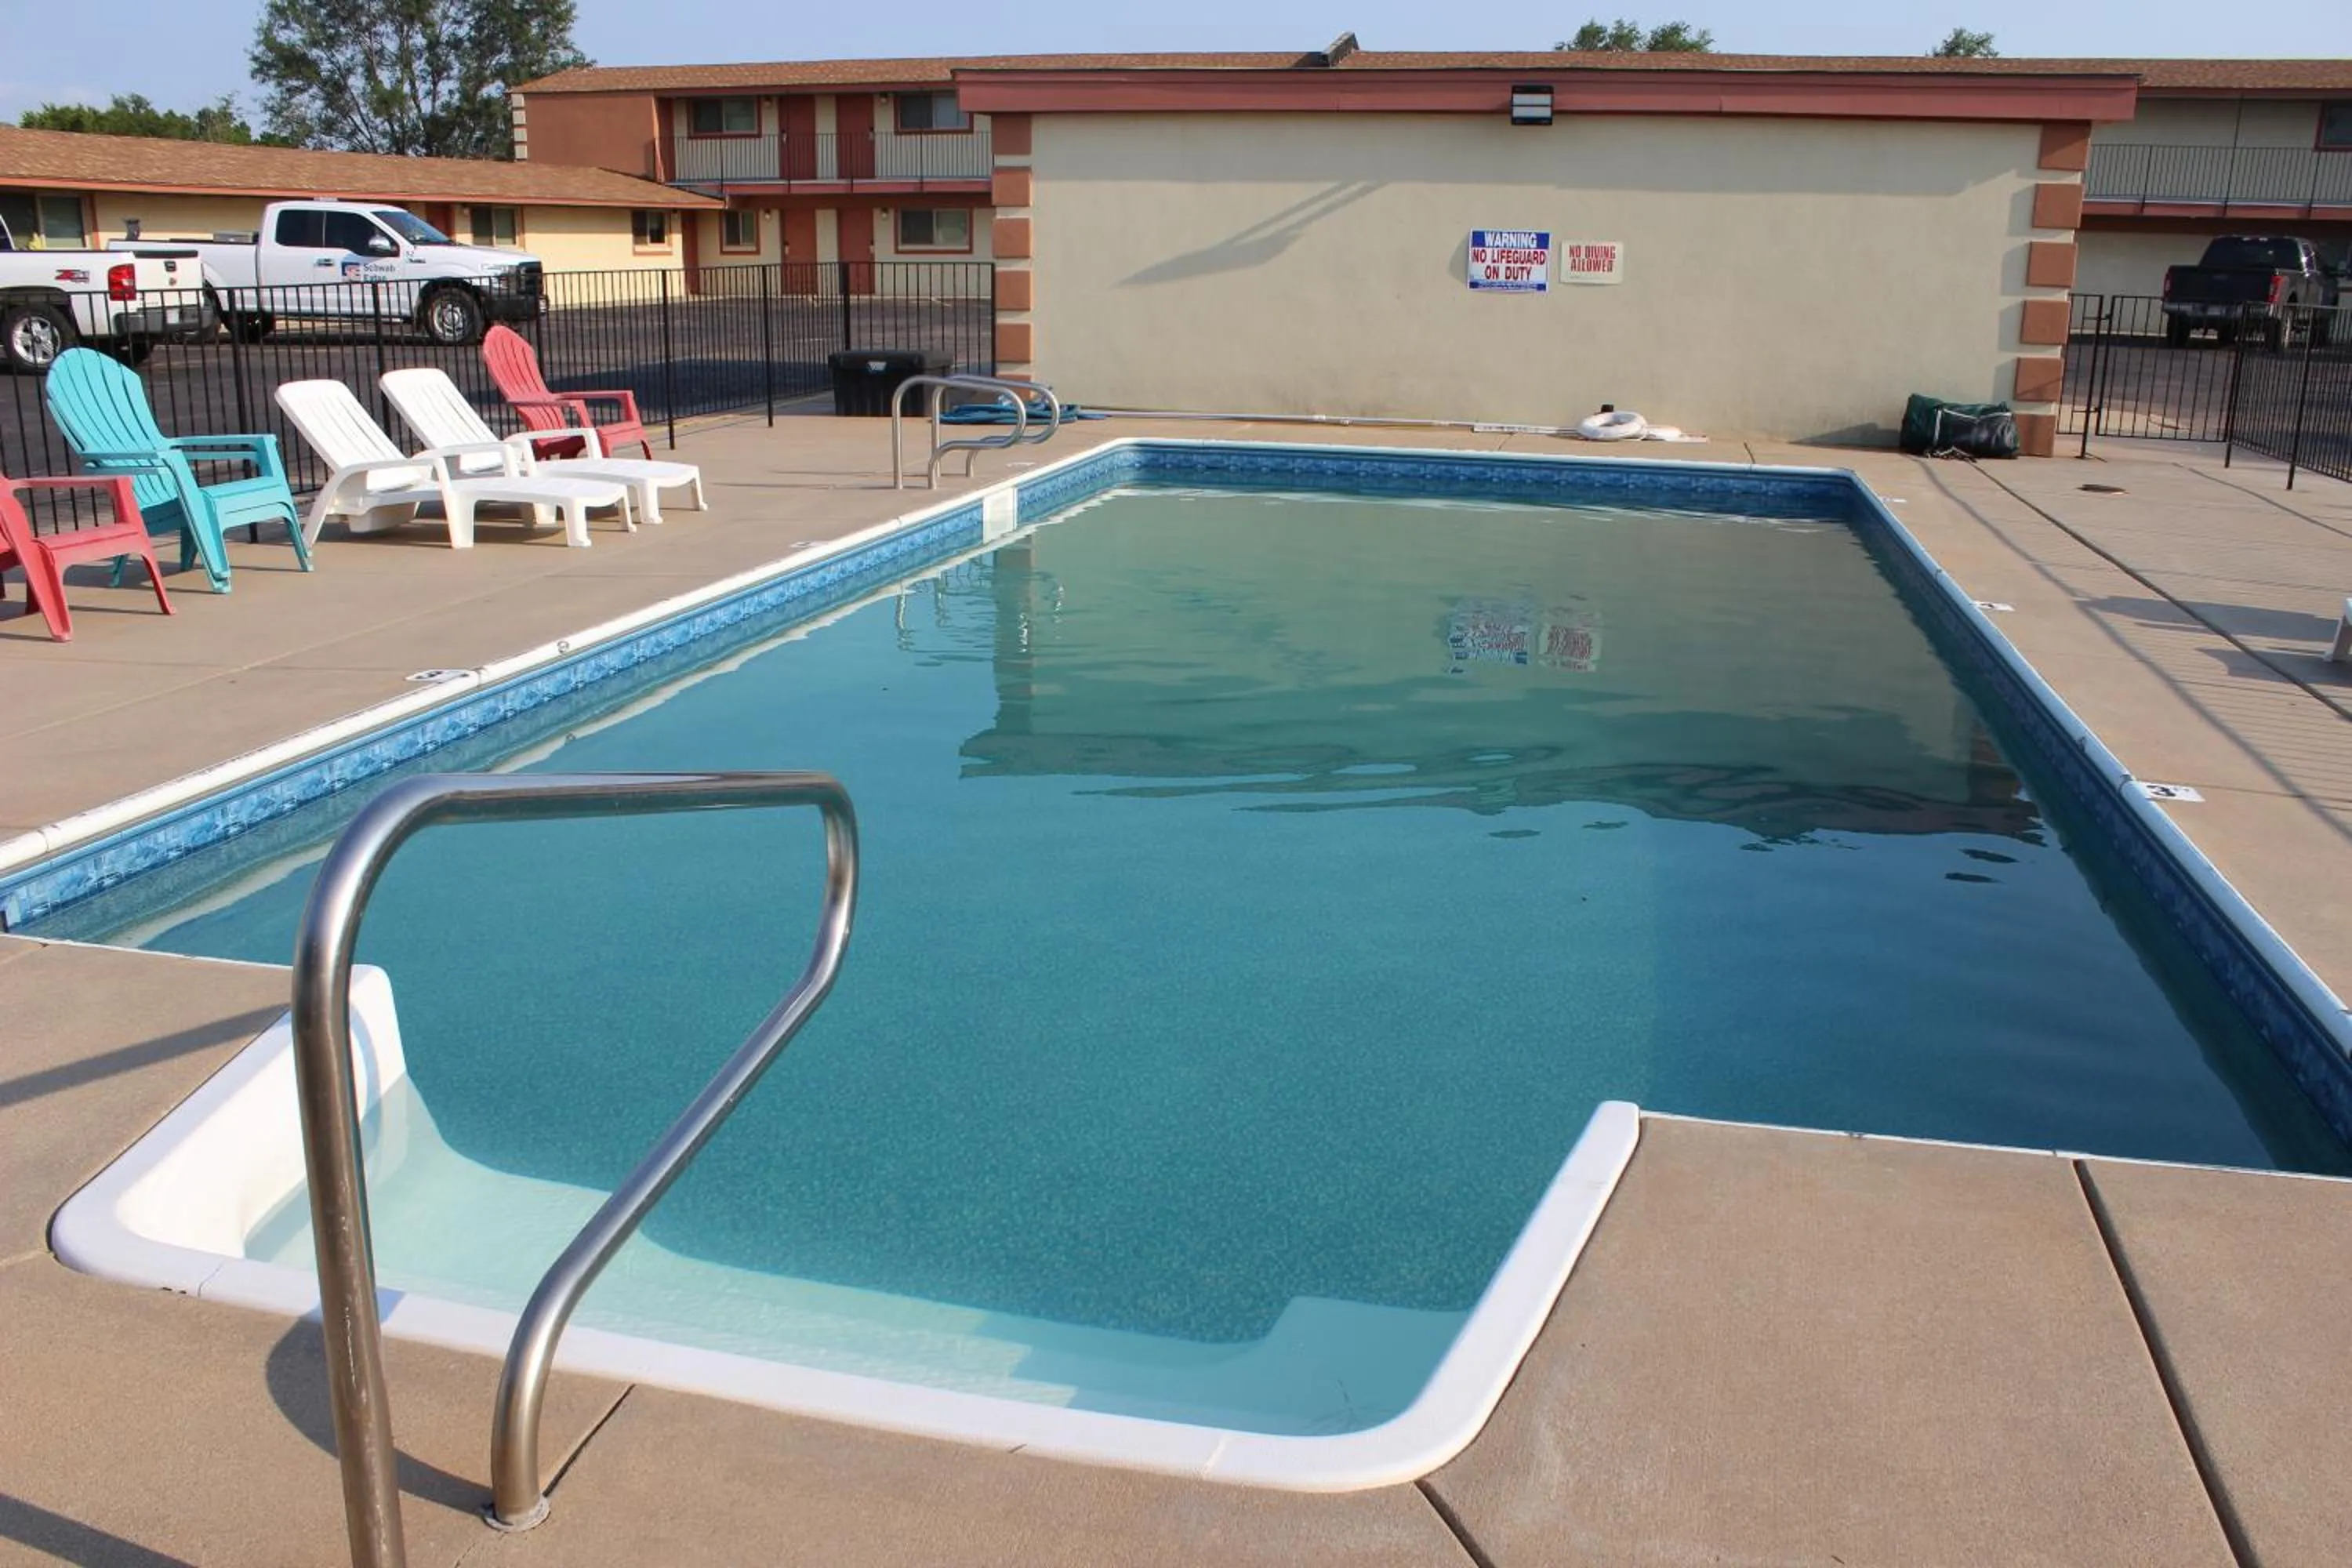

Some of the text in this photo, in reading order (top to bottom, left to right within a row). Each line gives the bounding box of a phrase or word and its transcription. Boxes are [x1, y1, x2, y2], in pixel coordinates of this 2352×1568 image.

[1484, 231, 1537, 249] WARNING
[1472, 249, 1547, 265] NO LIFEGUARD
[1569, 245, 1616, 259] NO DIVING
[1484, 265, 1533, 280] ON DUTY
[1570, 258, 1613, 273] ALLOWED
